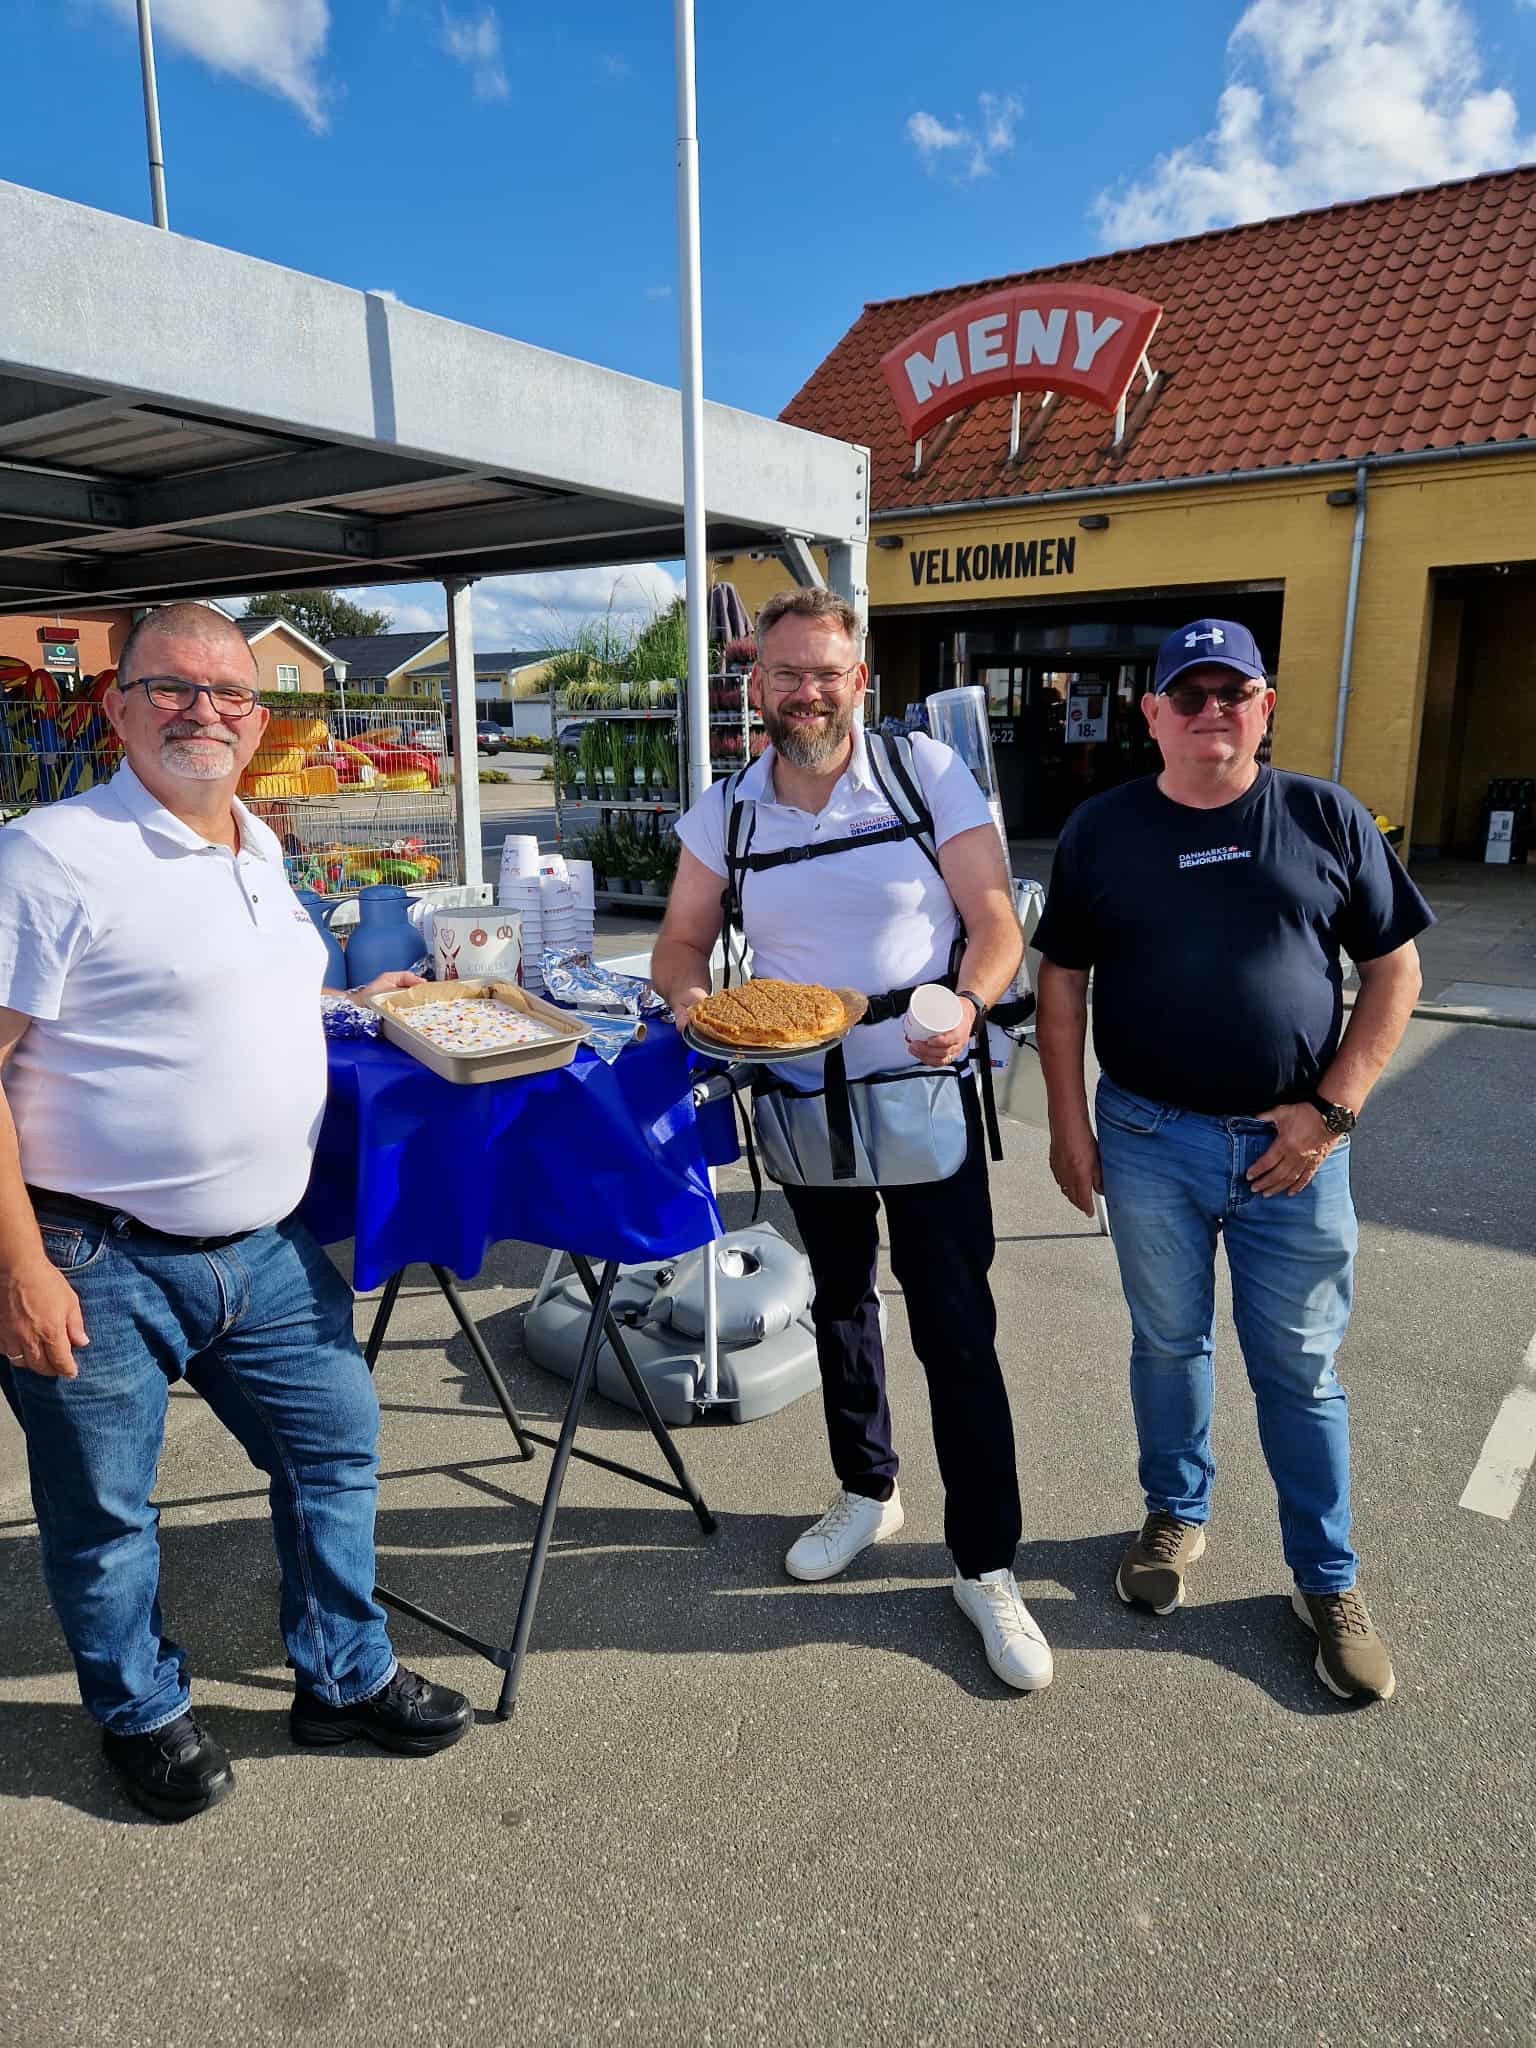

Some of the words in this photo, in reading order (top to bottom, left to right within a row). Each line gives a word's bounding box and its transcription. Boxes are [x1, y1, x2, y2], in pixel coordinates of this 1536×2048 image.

[904, 308, 1123, 405] MENY
[910, 536, 1076, 586] VELKOMMEN
[1179, 846, 1228, 861] DANMARKS
[1179, 850, 1252, 868] DEMOKRATERNE
